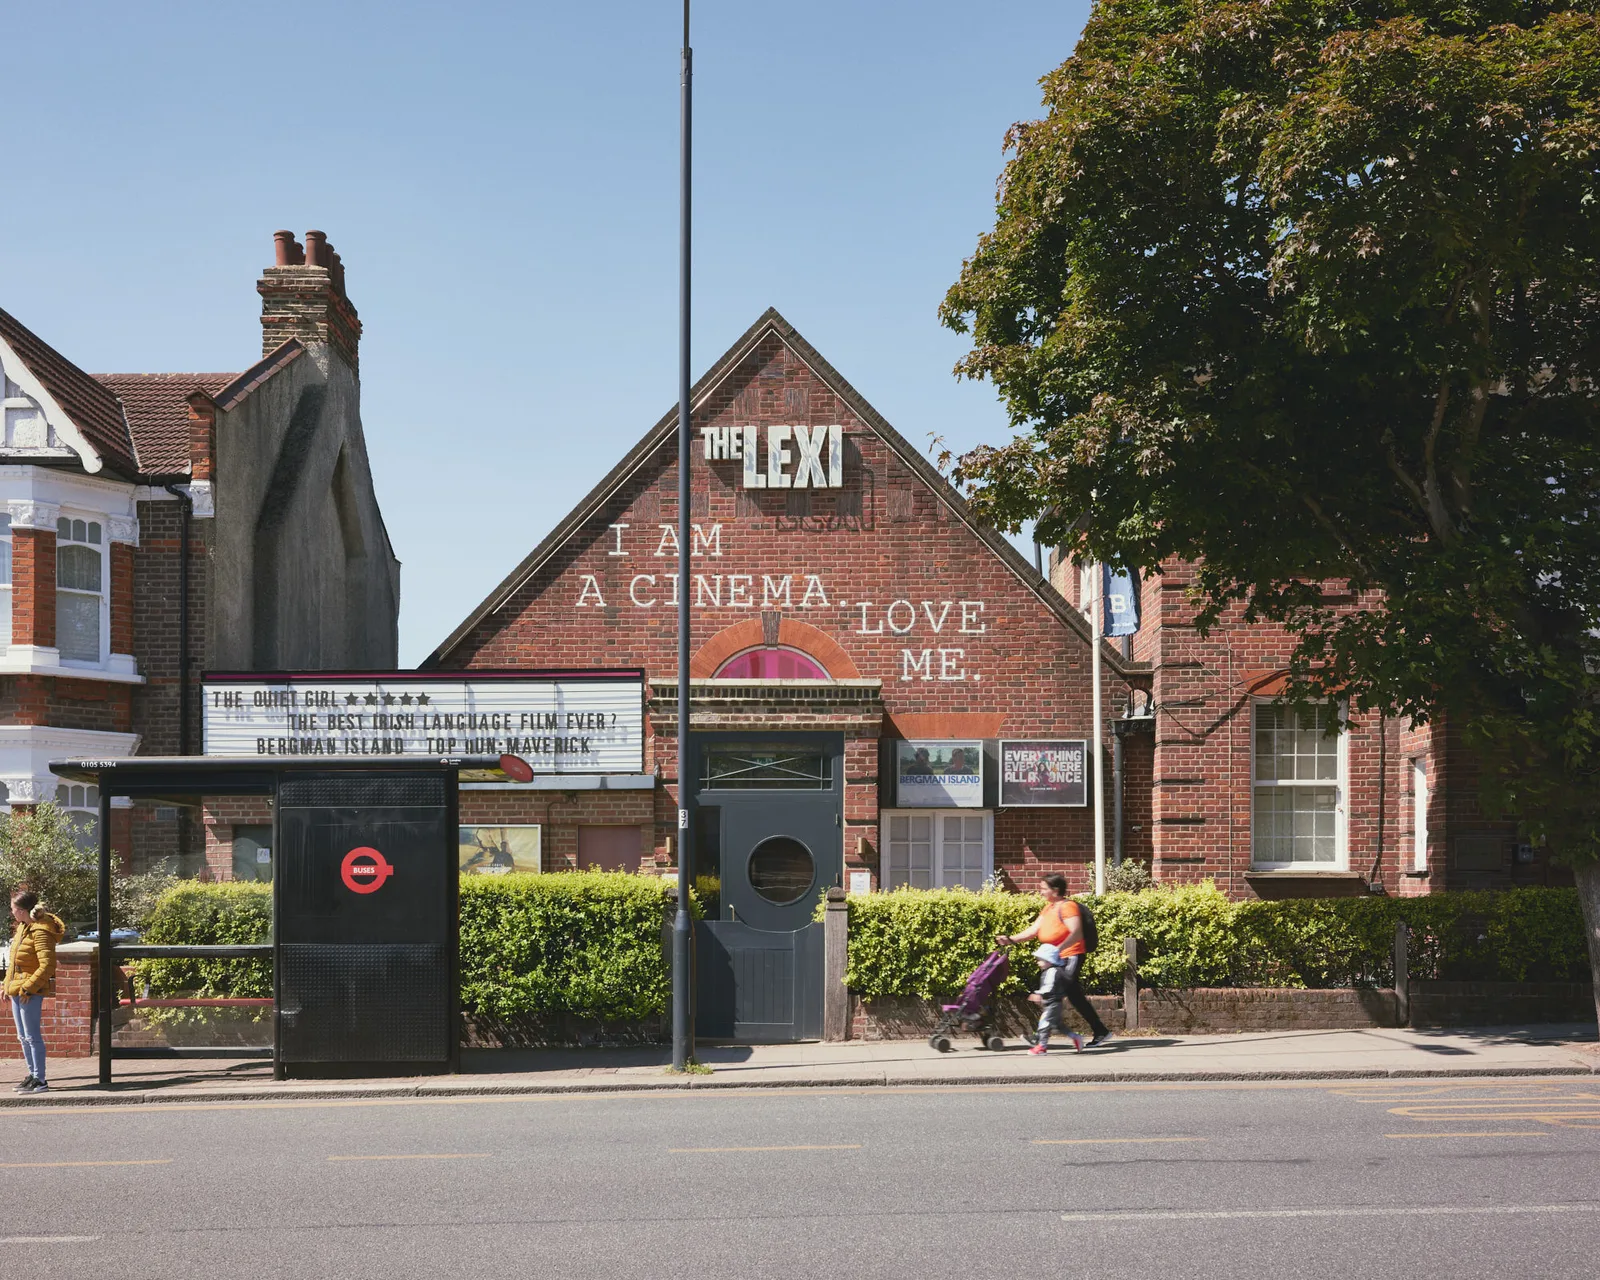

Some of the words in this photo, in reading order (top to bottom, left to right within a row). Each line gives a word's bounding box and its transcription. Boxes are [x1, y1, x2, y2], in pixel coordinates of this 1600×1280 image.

[701, 426, 743, 460] THE
[743, 425, 843, 489] LEXI
[608, 523, 630, 556] I
[654, 523, 723, 557] AM
[575, 574, 608, 607] A
[629, 573, 847, 608] CINEMA.
[855, 599, 986, 634] LOVE
[900, 648, 981, 681] ME.
[213, 691, 243, 708] THE
[253, 690, 298, 708] QUIET
[305, 690, 339, 708] GIRL
[289, 714, 318, 731] THE
[327, 713, 364, 731] BEST
[373, 713, 415, 731] IRISH
[423, 713, 512, 731] LANGUAGE
[521, 713, 558, 730] FILM
[256, 737, 337, 755] BERGMAN
[344, 737, 404, 755] ISLAND
[426, 737, 457, 755] TOP
[1004, 750, 1082, 761] EVERYTHING
[900, 775, 946, 784] BERGMAN
[948, 775, 980, 784] ISLAND
[1004, 772, 1022, 783] ALL
